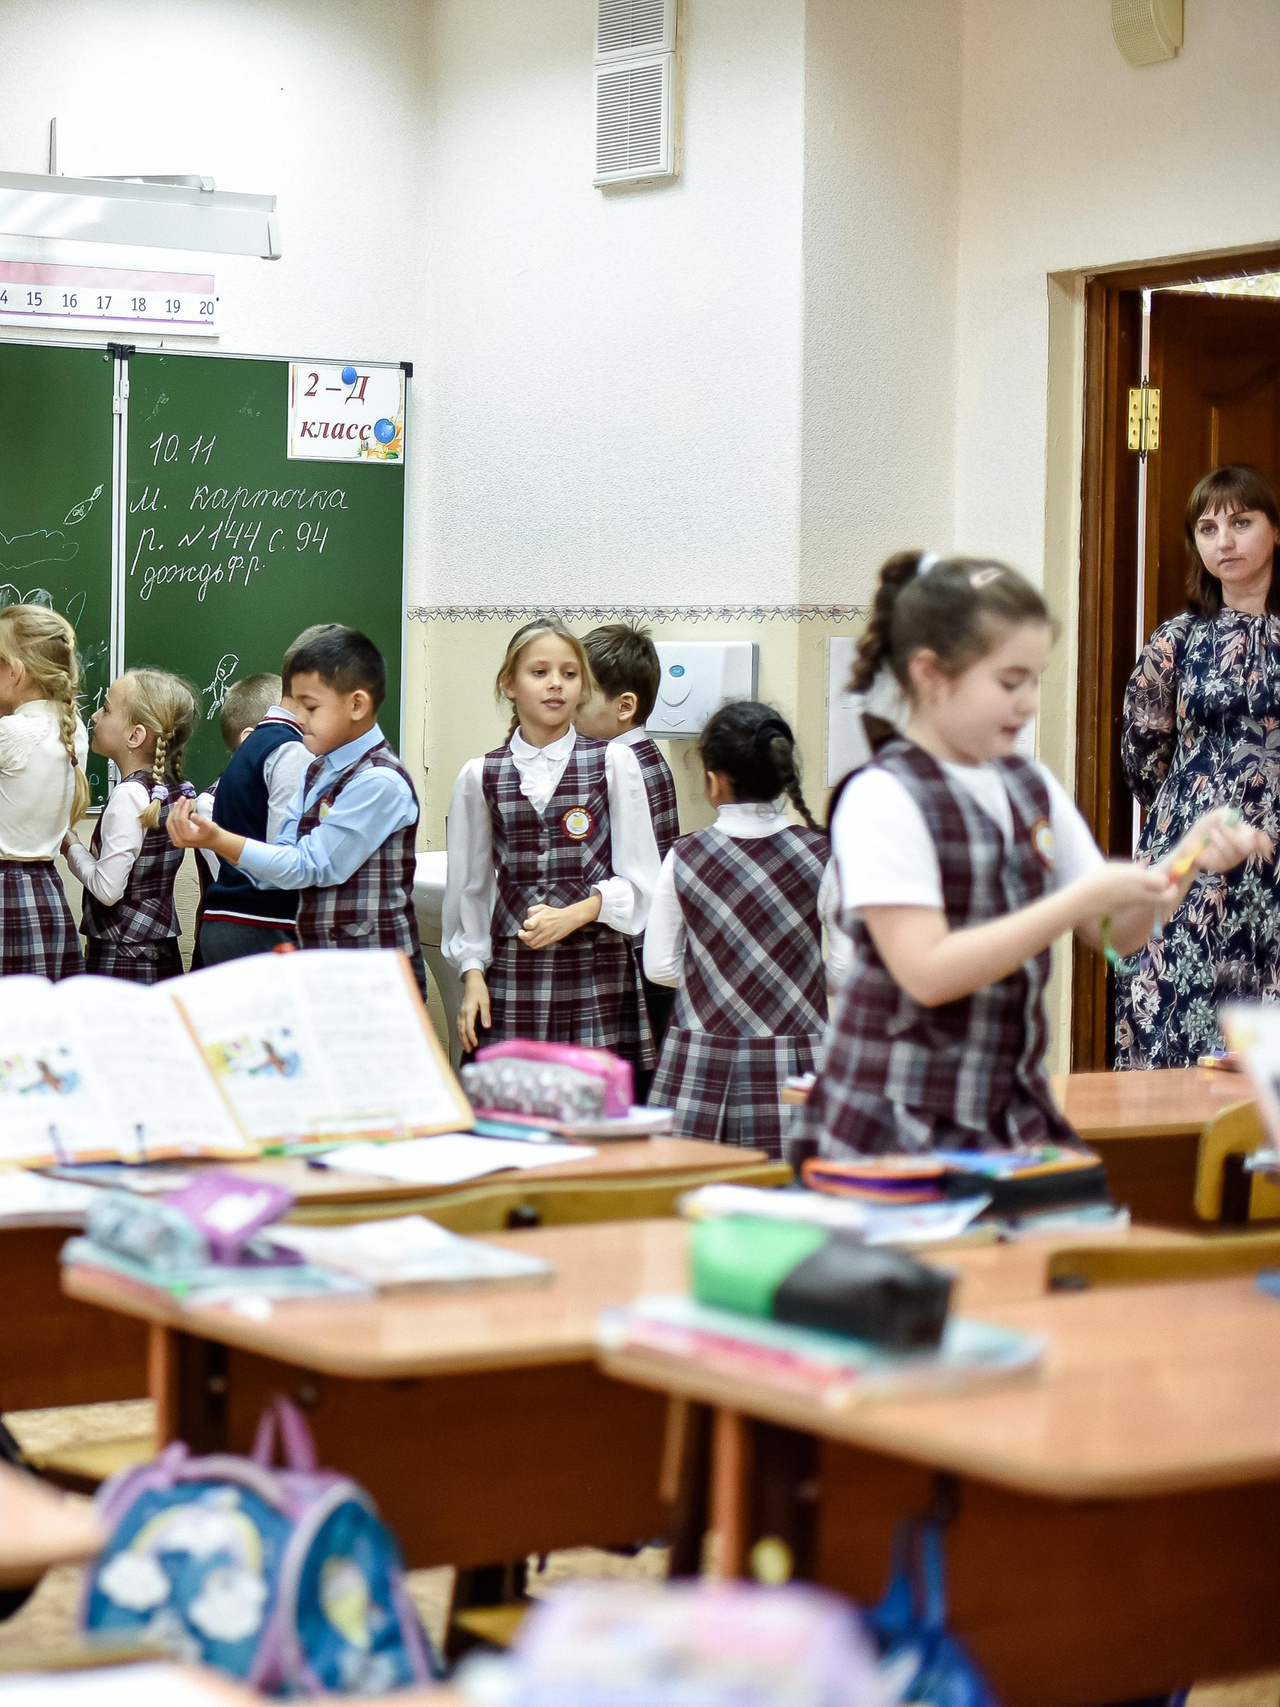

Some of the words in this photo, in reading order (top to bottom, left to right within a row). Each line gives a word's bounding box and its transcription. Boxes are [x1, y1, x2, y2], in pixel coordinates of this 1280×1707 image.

[27, 292, 42, 307] 15
[62, 294, 78, 309] 16
[97, 296, 112, 310] 17
[132, 298, 147, 312] 18
[165, 299, 181, 314] 19
[199, 301, 214, 316] 20
[304, 372, 319, 397] 2
[345, 375, 370, 405] Д
[300, 420, 372, 441] класс
[297, 521, 329, 553] 94
[140, 563, 224, 601] дождь
